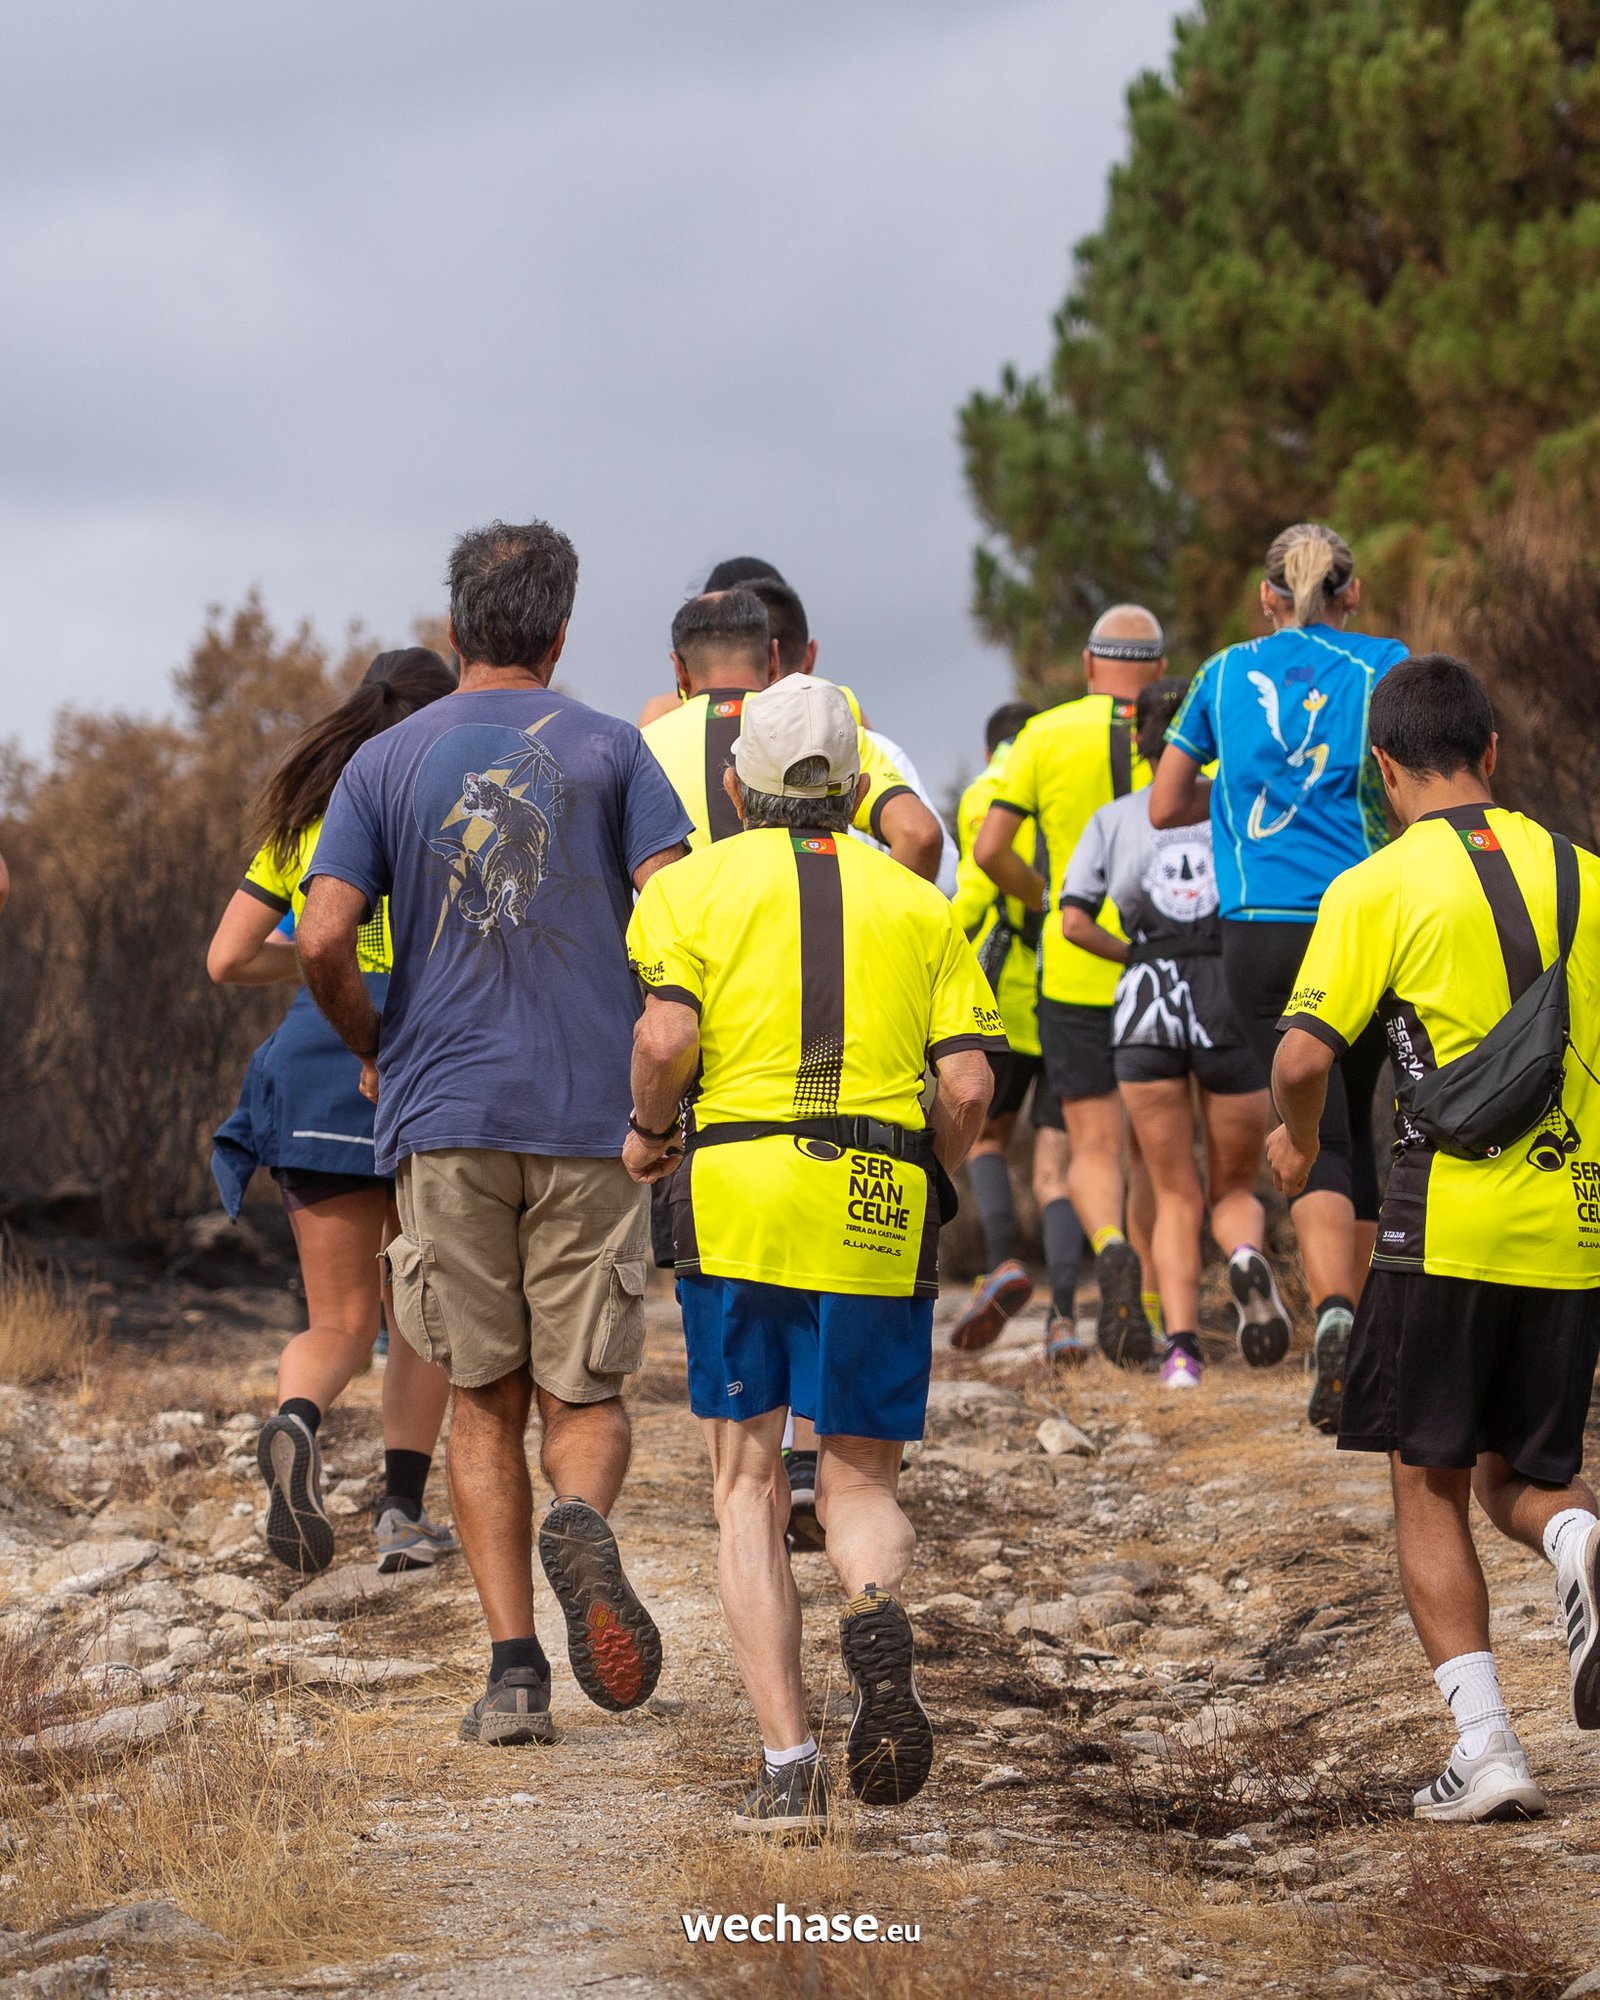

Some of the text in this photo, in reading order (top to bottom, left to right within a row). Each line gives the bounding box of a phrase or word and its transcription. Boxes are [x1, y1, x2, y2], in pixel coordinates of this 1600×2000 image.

[850, 1154, 895, 1182] SER
[849, 1175, 904, 1206] NAN
[847, 1199, 911, 1231] CELHE
[845, 1223, 907, 1242] TERRA DA CASTANHA
[842, 1239, 902, 1257] RUNNERS
